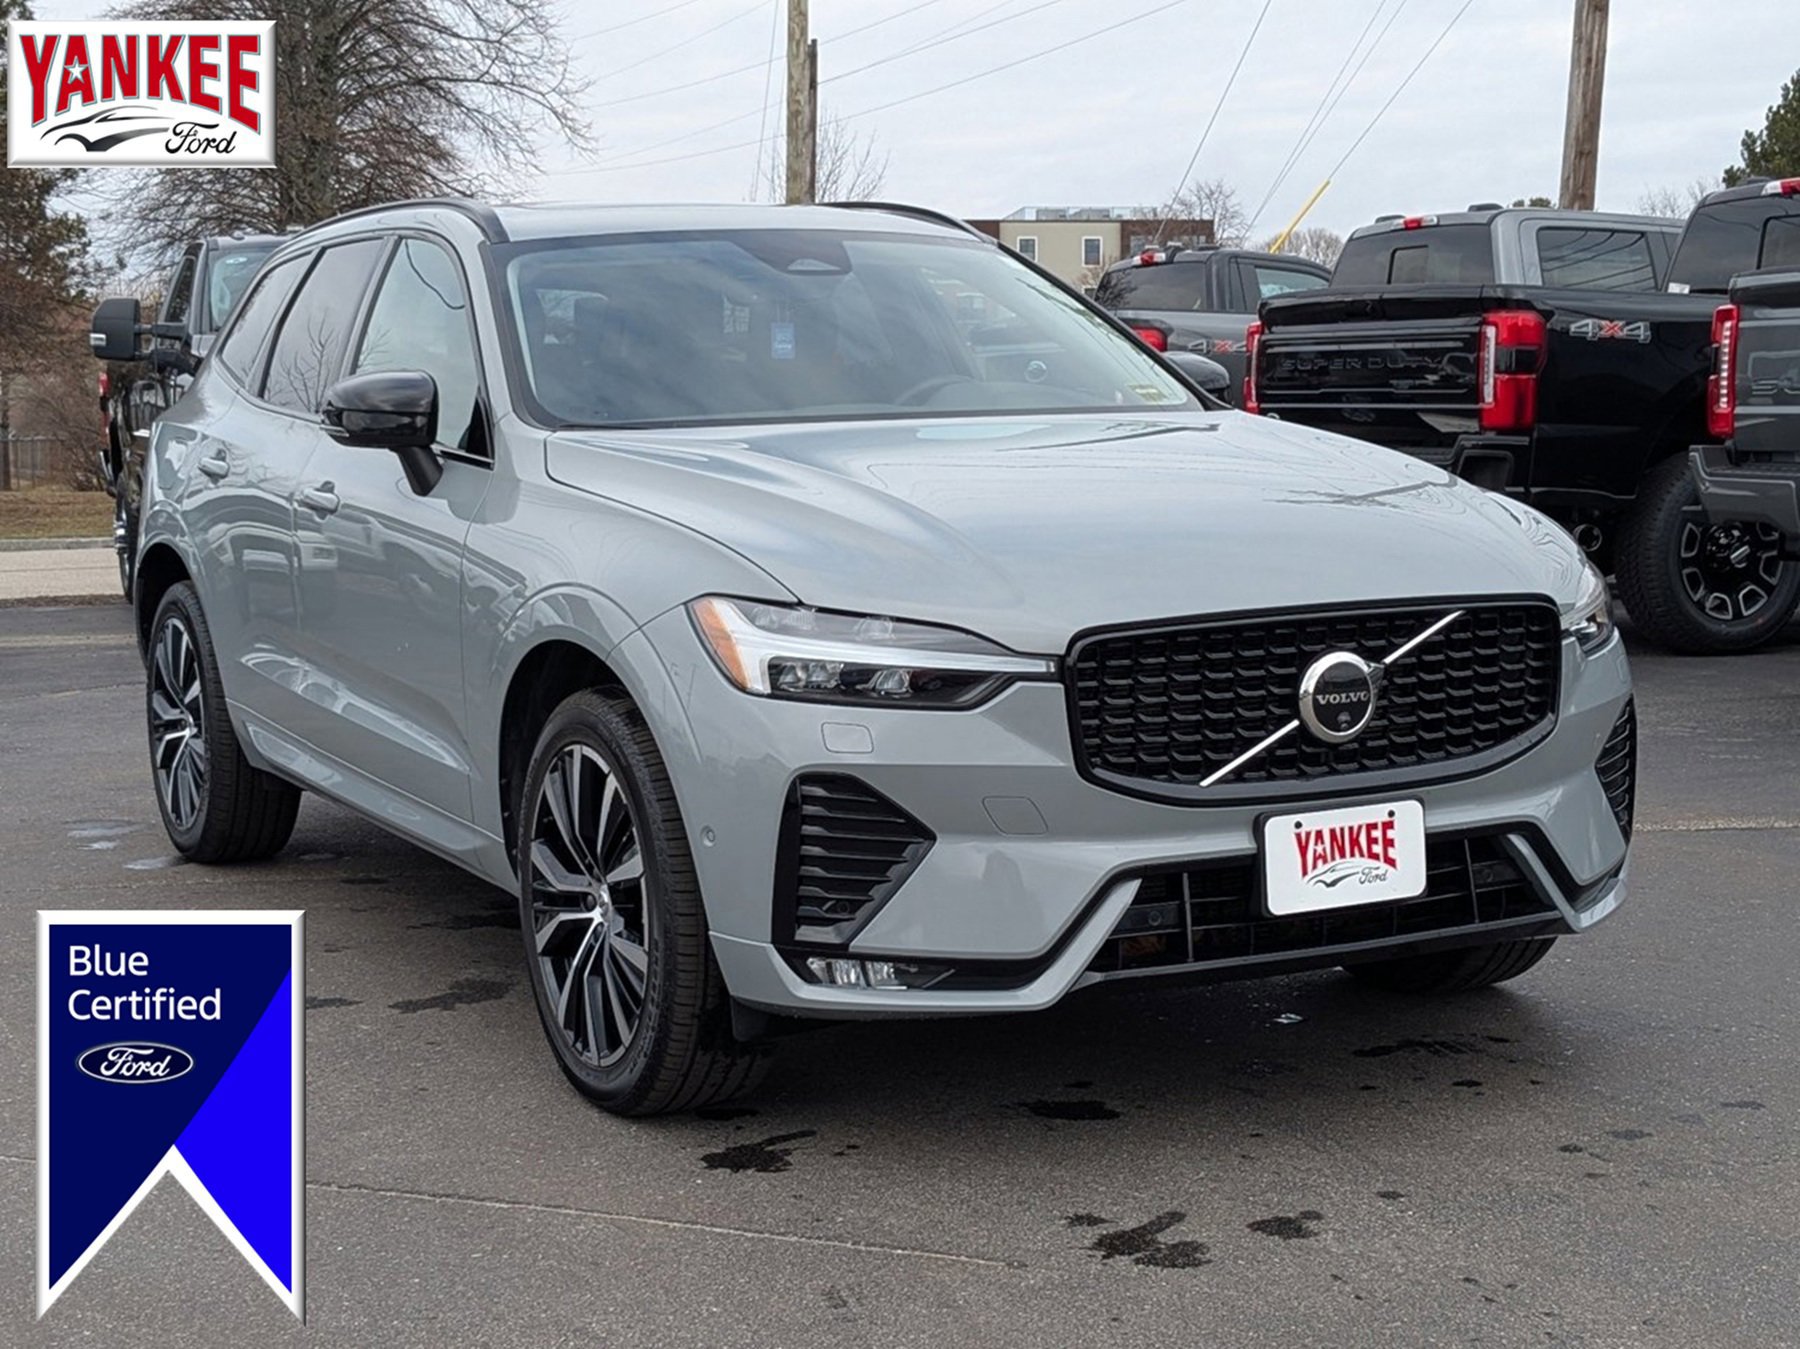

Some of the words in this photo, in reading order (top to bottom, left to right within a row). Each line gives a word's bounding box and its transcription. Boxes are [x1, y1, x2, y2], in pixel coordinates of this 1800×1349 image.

[1281, 357, 1361, 371] SUPER
[1368, 355, 1442, 369] DUTY
[1316, 691, 1369, 705] VOLVO
[1294, 819, 1398, 880] YANKEE
[1358, 866, 1389, 885] Ford
